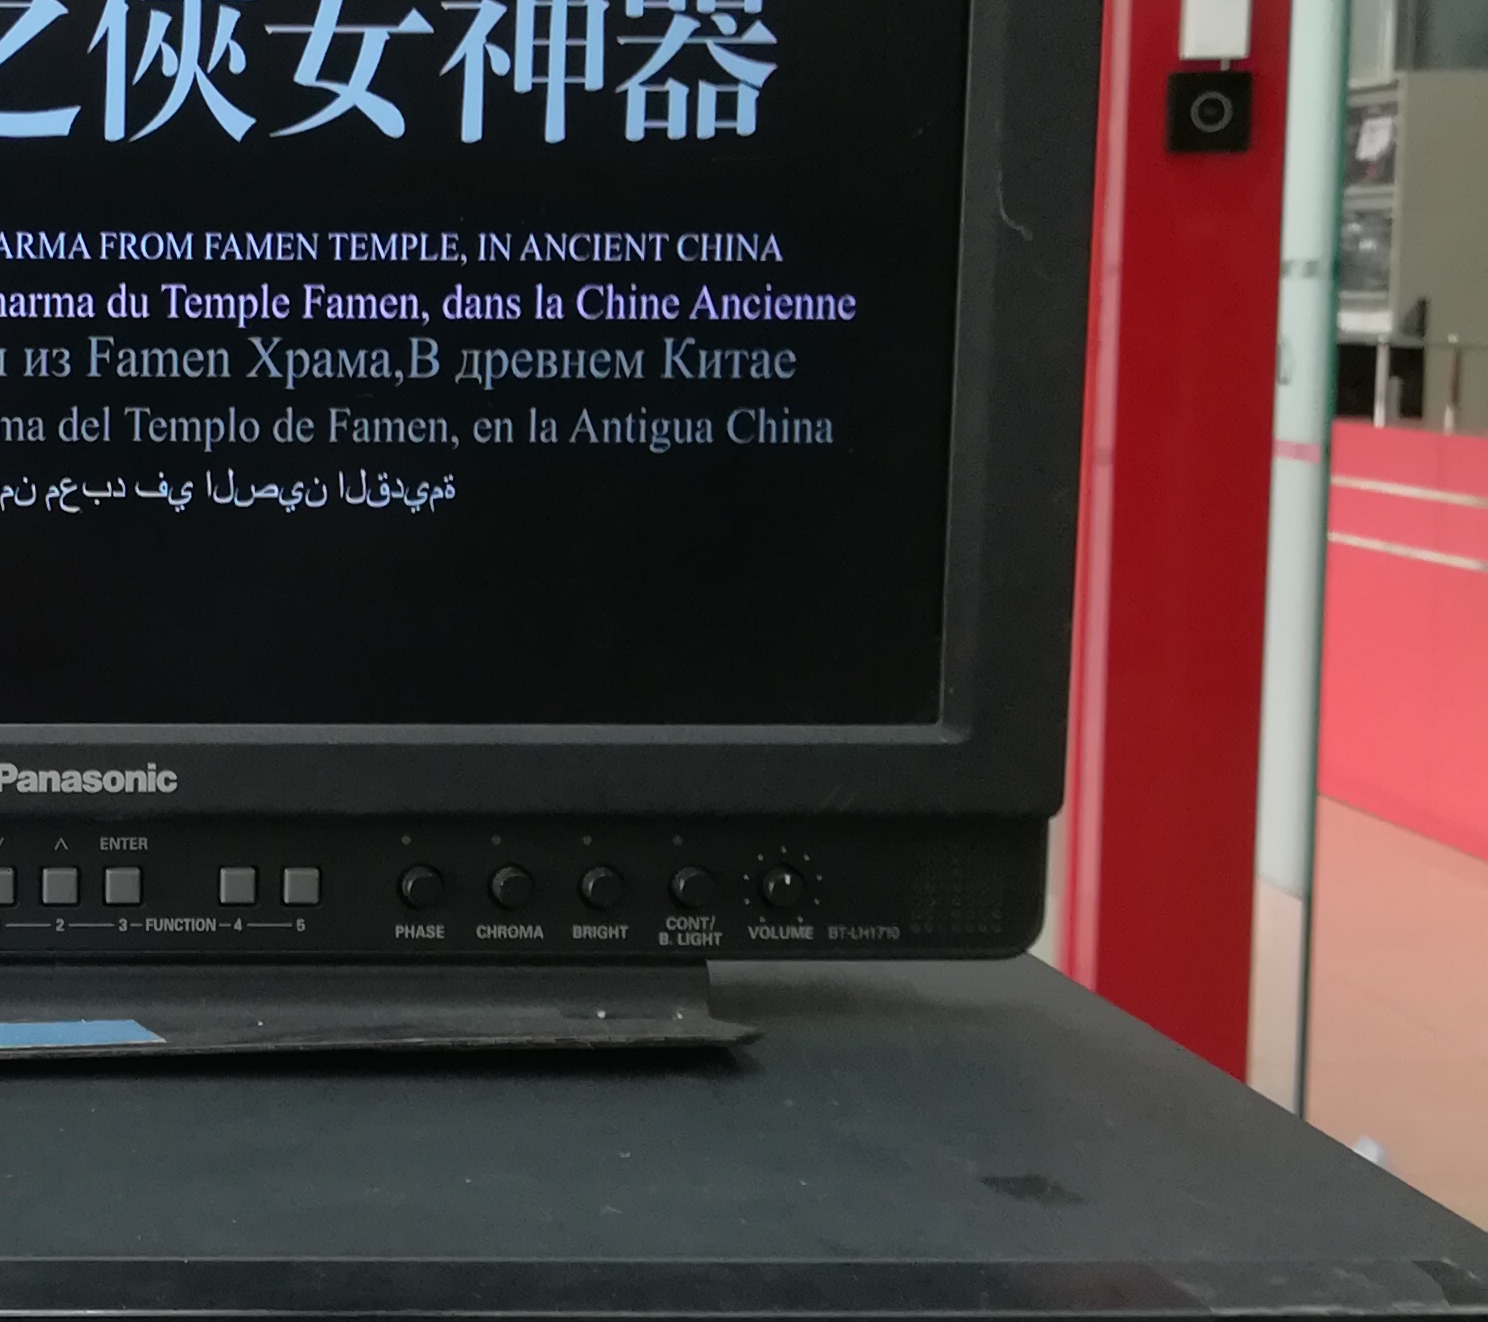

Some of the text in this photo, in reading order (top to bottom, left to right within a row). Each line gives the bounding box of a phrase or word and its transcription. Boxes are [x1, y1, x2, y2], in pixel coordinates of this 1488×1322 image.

[98, 231, 194, 261] FROM
[203, 231, 319, 262] FAMEN
[328, 232, 468, 266] TEMPLE,
[477, 232, 512, 262] IN
[519, 232, 670, 263] ANCIENT
[676, 233, 784, 263] CHINA
[107, 283, 150, 320] du
[160, 283, 291, 328] Temple
[302, 283, 431, 326] Famen,
[441, 283, 522, 322] dans
[534, 283, 565, 322] la
[575, 283, 680, 322] Chine
[689, 283, 857, 322] Ancienne
[23, 347, 72, 378] из
[86, 336, 231, 379] Famen
[455, 347, 646, 391] древнем
[661, 336, 797, 380] Китае
[57, 405, 112, 443] del
[123, 406, 260, 453] Templo
[272, 406, 316, 444] de
[328, 407, 461, 449] Famen,
[472, 416, 514, 445] en
[528, 407, 559, 444] la
[569, 407, 714, 454] Antigua
[725, 407, 835, 444] China
[99, 837, 149, 852] ENTER
[394, 924, 446, 940] PHASE
[475, 924, 545, 941] CHROMA
[572, 924, 630, 941] BRIGHT
[665, 915, 717, 933] CONT/
[747, 924, 815, 941] VOLUME
[672, 931, 723, 947] LIGHT
